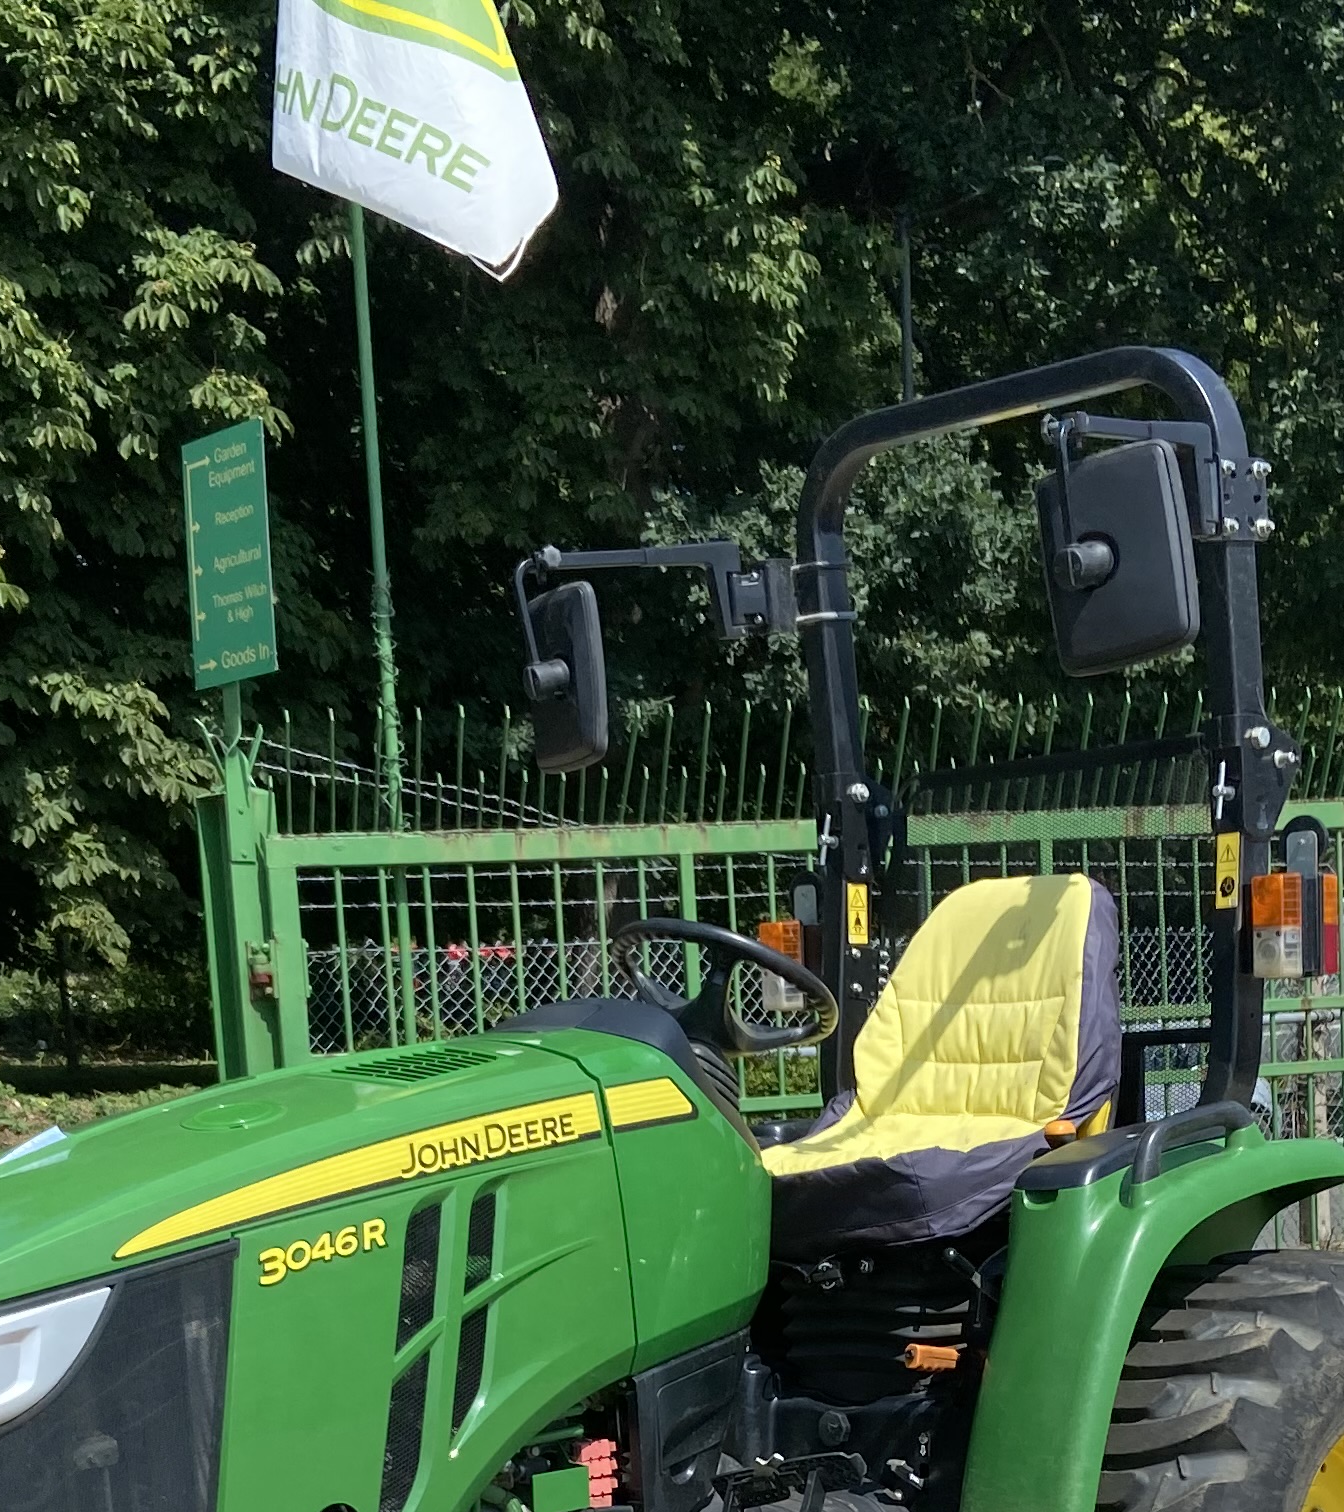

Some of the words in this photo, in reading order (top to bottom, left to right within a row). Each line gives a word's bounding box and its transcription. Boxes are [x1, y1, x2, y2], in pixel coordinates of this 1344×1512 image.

[274, 64, 321, 122] HN
[320, 72, 492, 194] DEERE
[213, 442, 247, 464] Garden
[208, 460, 256, 488] Equipment
[215, 504, 254, 525] Reception
[213, 544, 262, 574] Agricultural
[212, 591, 244, 609] Thomas
[235, 605, 254, 623] High
[221, 645, 257, 669] Goods
[258, 642, 271, 660] In
[401, 1133, 481, 1175] JOHN
[484, 1112, 576, 1154] DEERE
